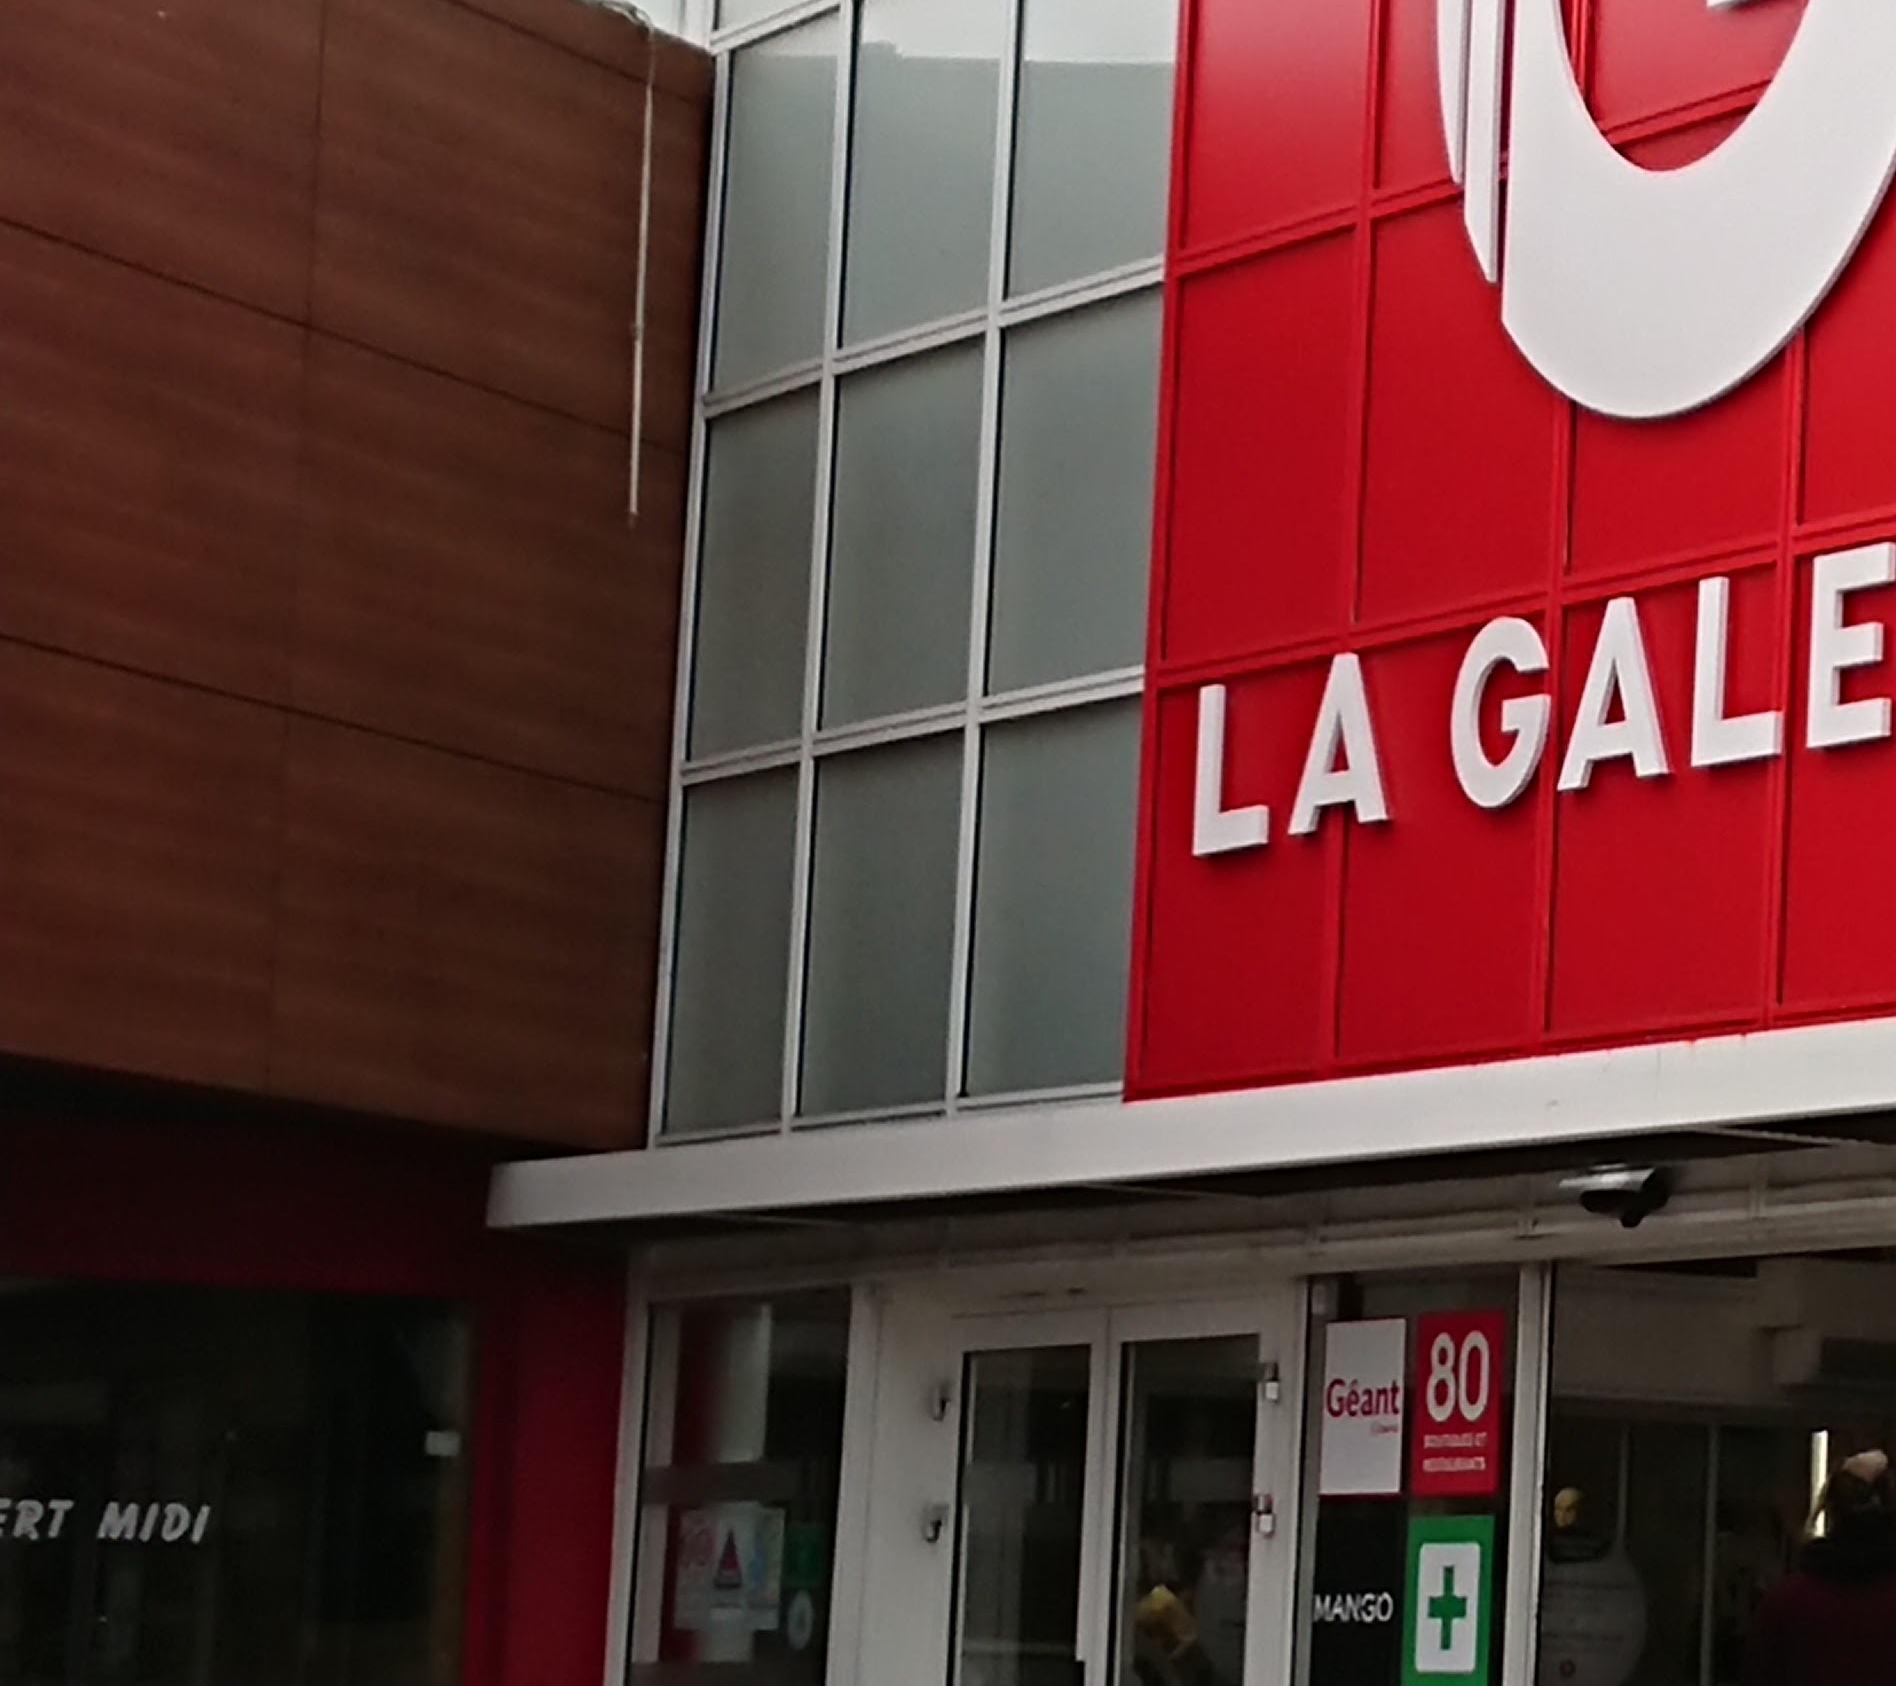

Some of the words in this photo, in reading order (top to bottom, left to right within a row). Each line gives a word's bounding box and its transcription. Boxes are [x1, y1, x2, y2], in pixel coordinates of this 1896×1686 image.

[1192, 651, 1392, 858] LA
[1326, 1377, 1400, 1418] Géant
[1427, 1331, 1490, 1421] 80
[97, 1500, 211, 1544] MIDI
[1313, 1592, 1394, 1622] MANGO
